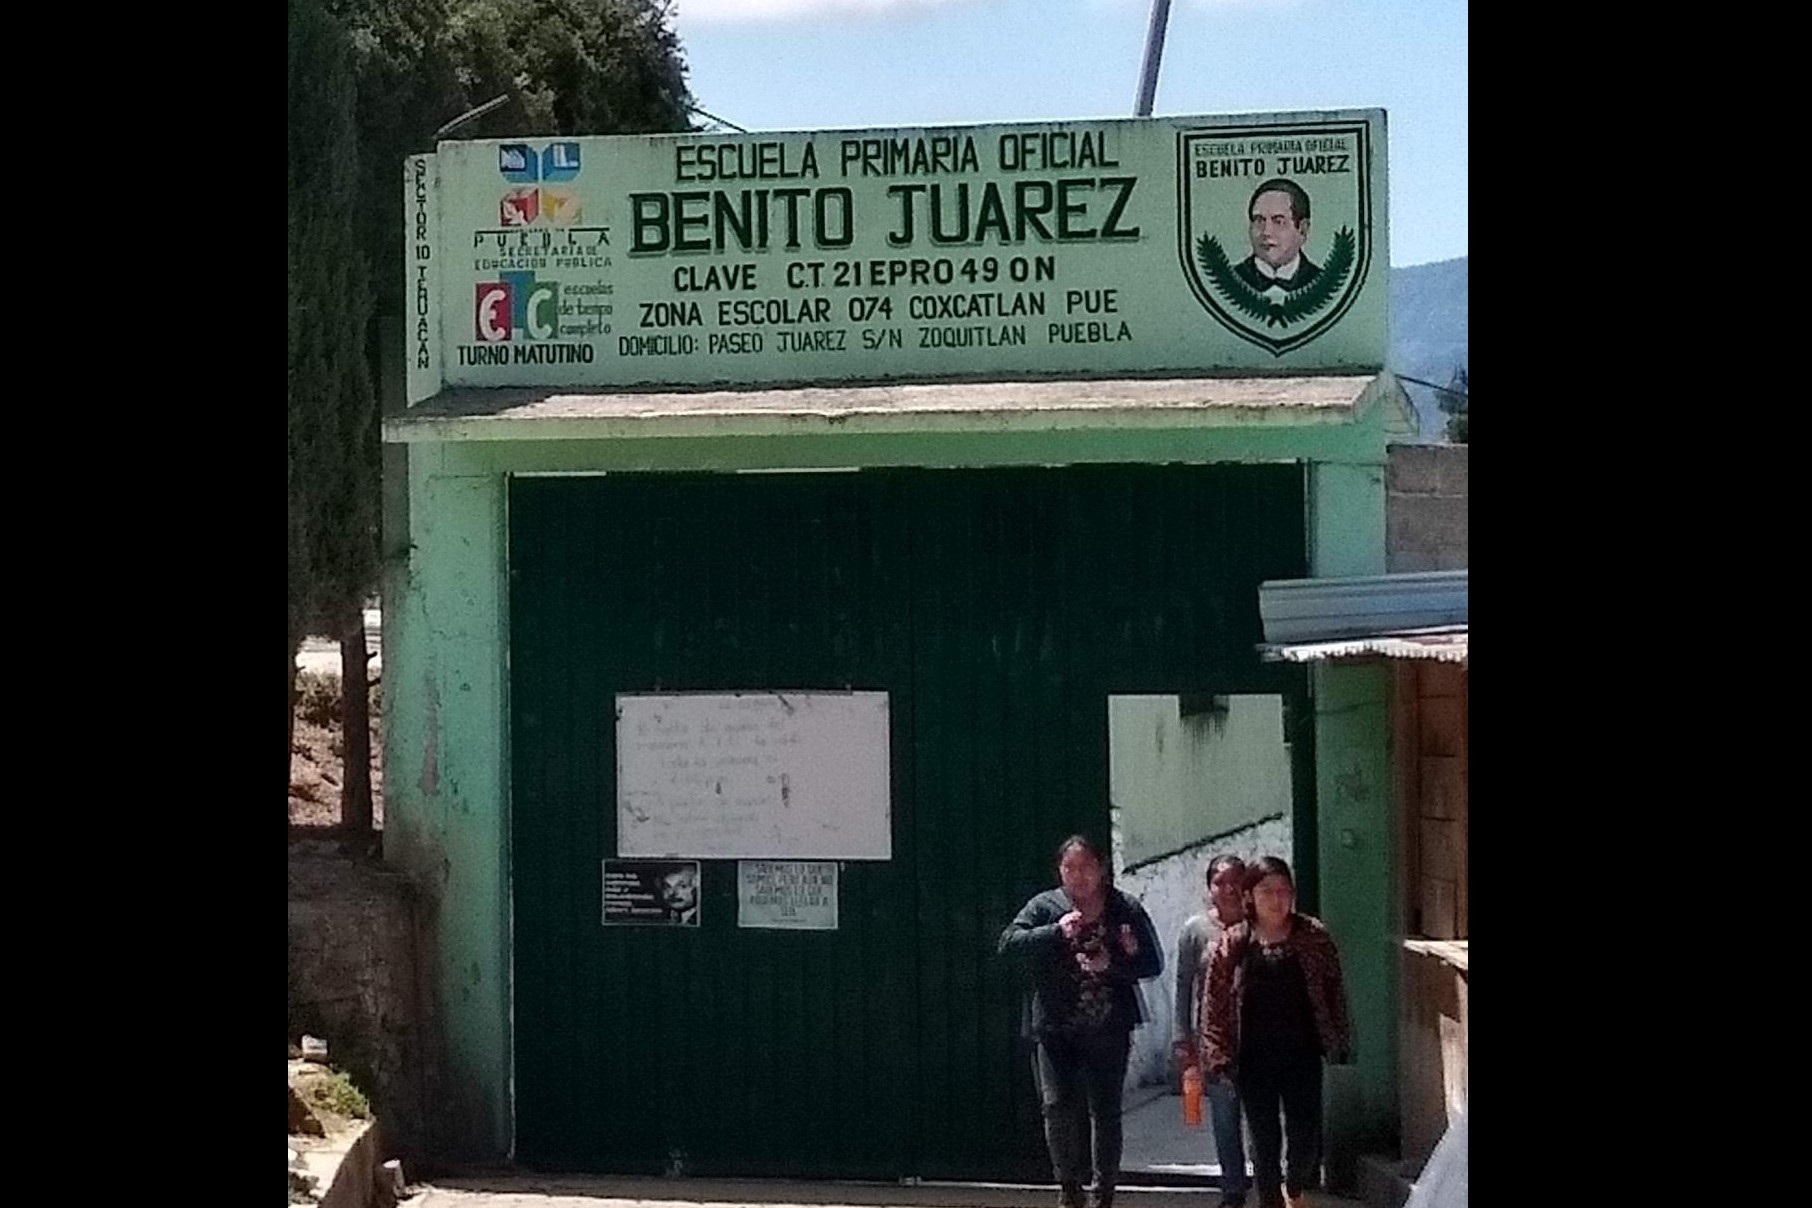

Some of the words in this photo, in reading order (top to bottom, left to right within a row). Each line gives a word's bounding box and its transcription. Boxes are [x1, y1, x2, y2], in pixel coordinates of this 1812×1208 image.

[675, 142, 819, 181] ESCUELA
[841, 136, 979, 177] PRIMARIA
[999, 130, 1119, 171] OFICIAL
[1196, 157, 1265, 178] BENITO
[1277, 154, 1350, 176] JUAREZ
[415, 159, 427, 240] SECTOR
[628, 186, 855, 257] BENITO
[887, 176, 1141, 247] JUAREZ
[674, 264, 757, 292] CLAVE
[639, 302, 703, 327] ZONA
[718, 298, 830, 325] ESCOLAR
[848, 296, 892, 322] 074
[909, 292, 1045, 320] COXCATLAN
[1067, 289, 1118, 315] PUE
[458, 345, 509, 366] TURNO
[513, 343, 594, 364] MATUTINO
[618, 335, 699, 357] DOMICILIO:
[709, 332, 763, 355] PASEO
[777, 329, 846, 353] JUAREZ
[862, 328, 902, 350] S/N
[919, 325, 1026, 349] ZOQUITLAN
[1049, 321, 1132, 344] PUEBLA
